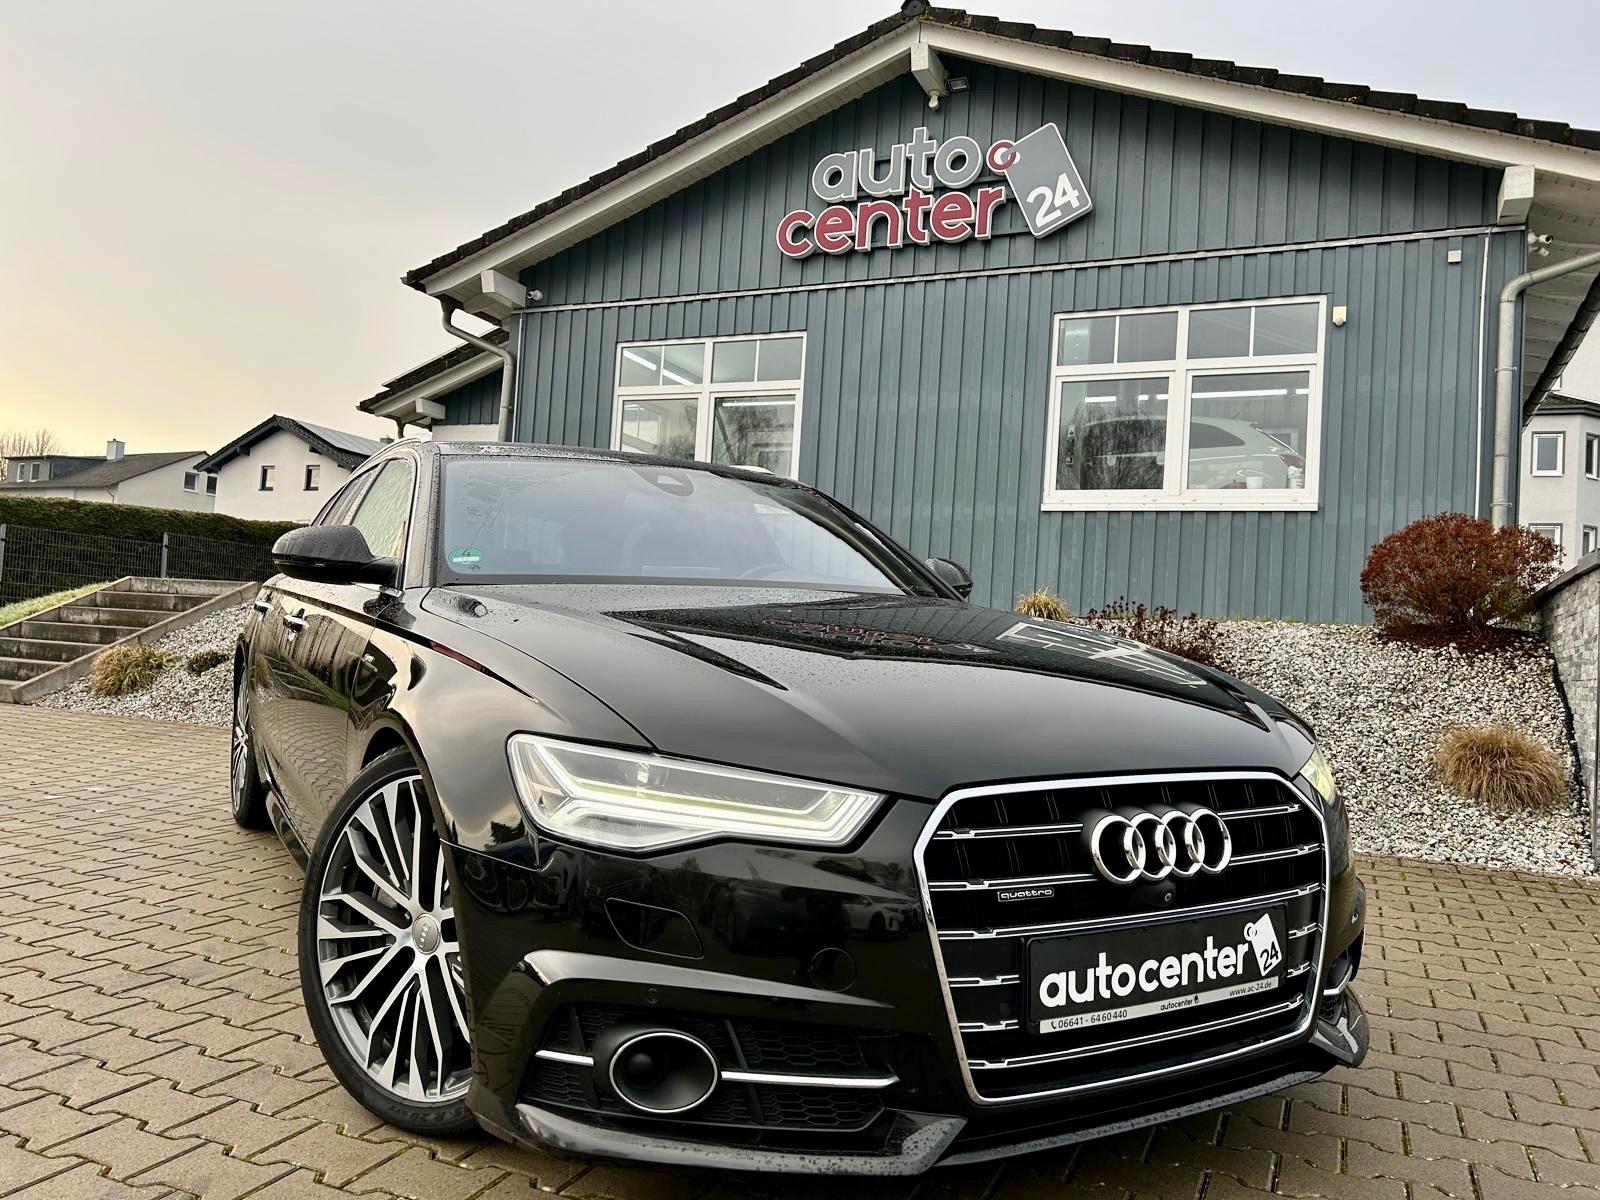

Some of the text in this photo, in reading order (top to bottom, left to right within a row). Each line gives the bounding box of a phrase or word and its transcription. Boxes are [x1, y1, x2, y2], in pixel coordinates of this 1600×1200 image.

[812, 126, 983, 203] auto
[1026, 173, 1080, 229] 24
[776, 184, 1006, 259] center
[1000, 889, 1053, 900] quattro
[1260, 941, 1280, 970] 24
[1039, 936, 1249, 1007] autocenter
[1229, 980, 1272, 996] www.ac-24.de
[1160, 997, 1194, 1011] autocenter
[1058, 1016, 1084, 1029] 06641
